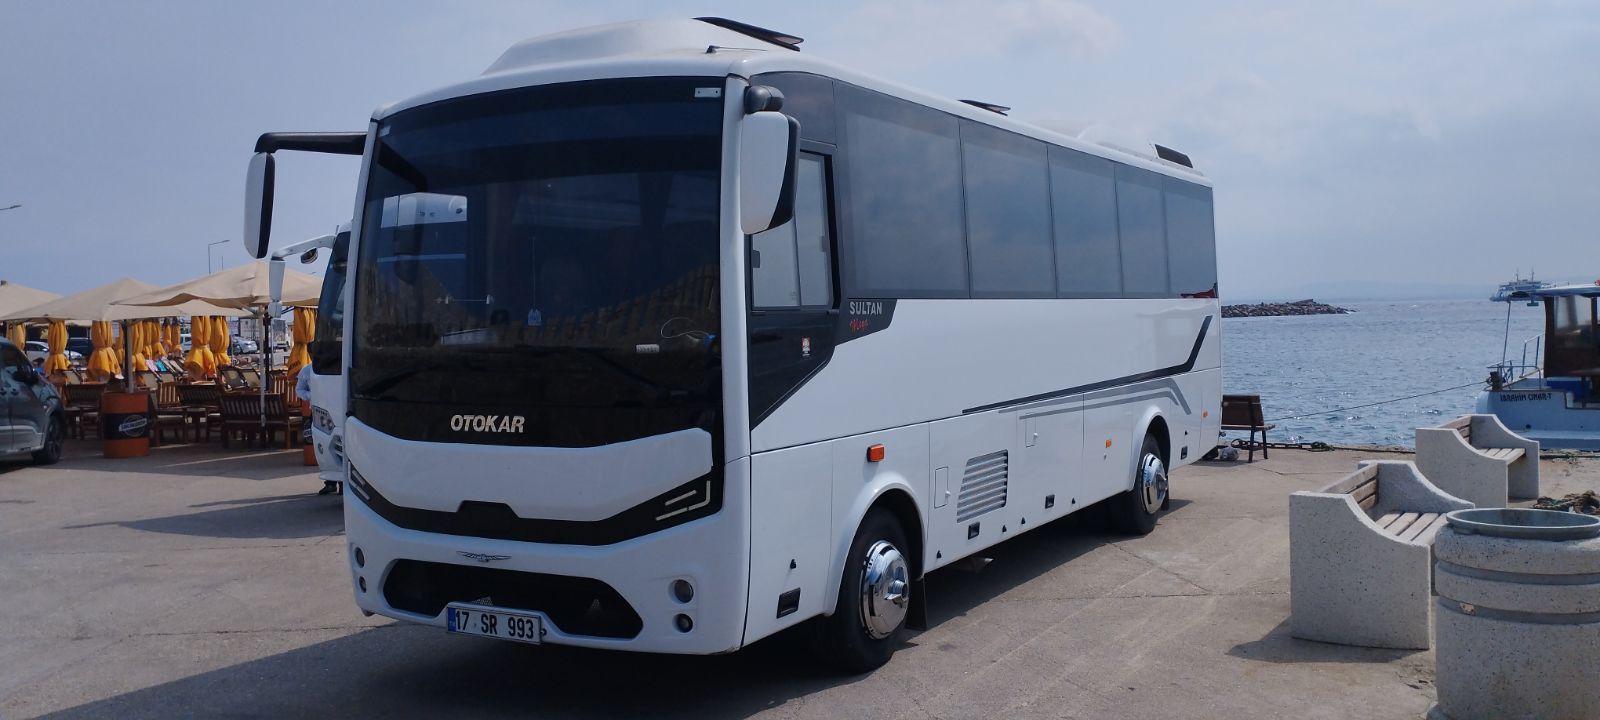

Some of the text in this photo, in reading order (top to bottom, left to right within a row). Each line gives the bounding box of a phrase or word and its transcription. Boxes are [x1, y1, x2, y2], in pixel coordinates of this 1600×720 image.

[850, 301, 883, 315] SULTAN
[450, 414, 525, 433] OTOKAR
[456, 611, 534, 640] 17 SR 993
